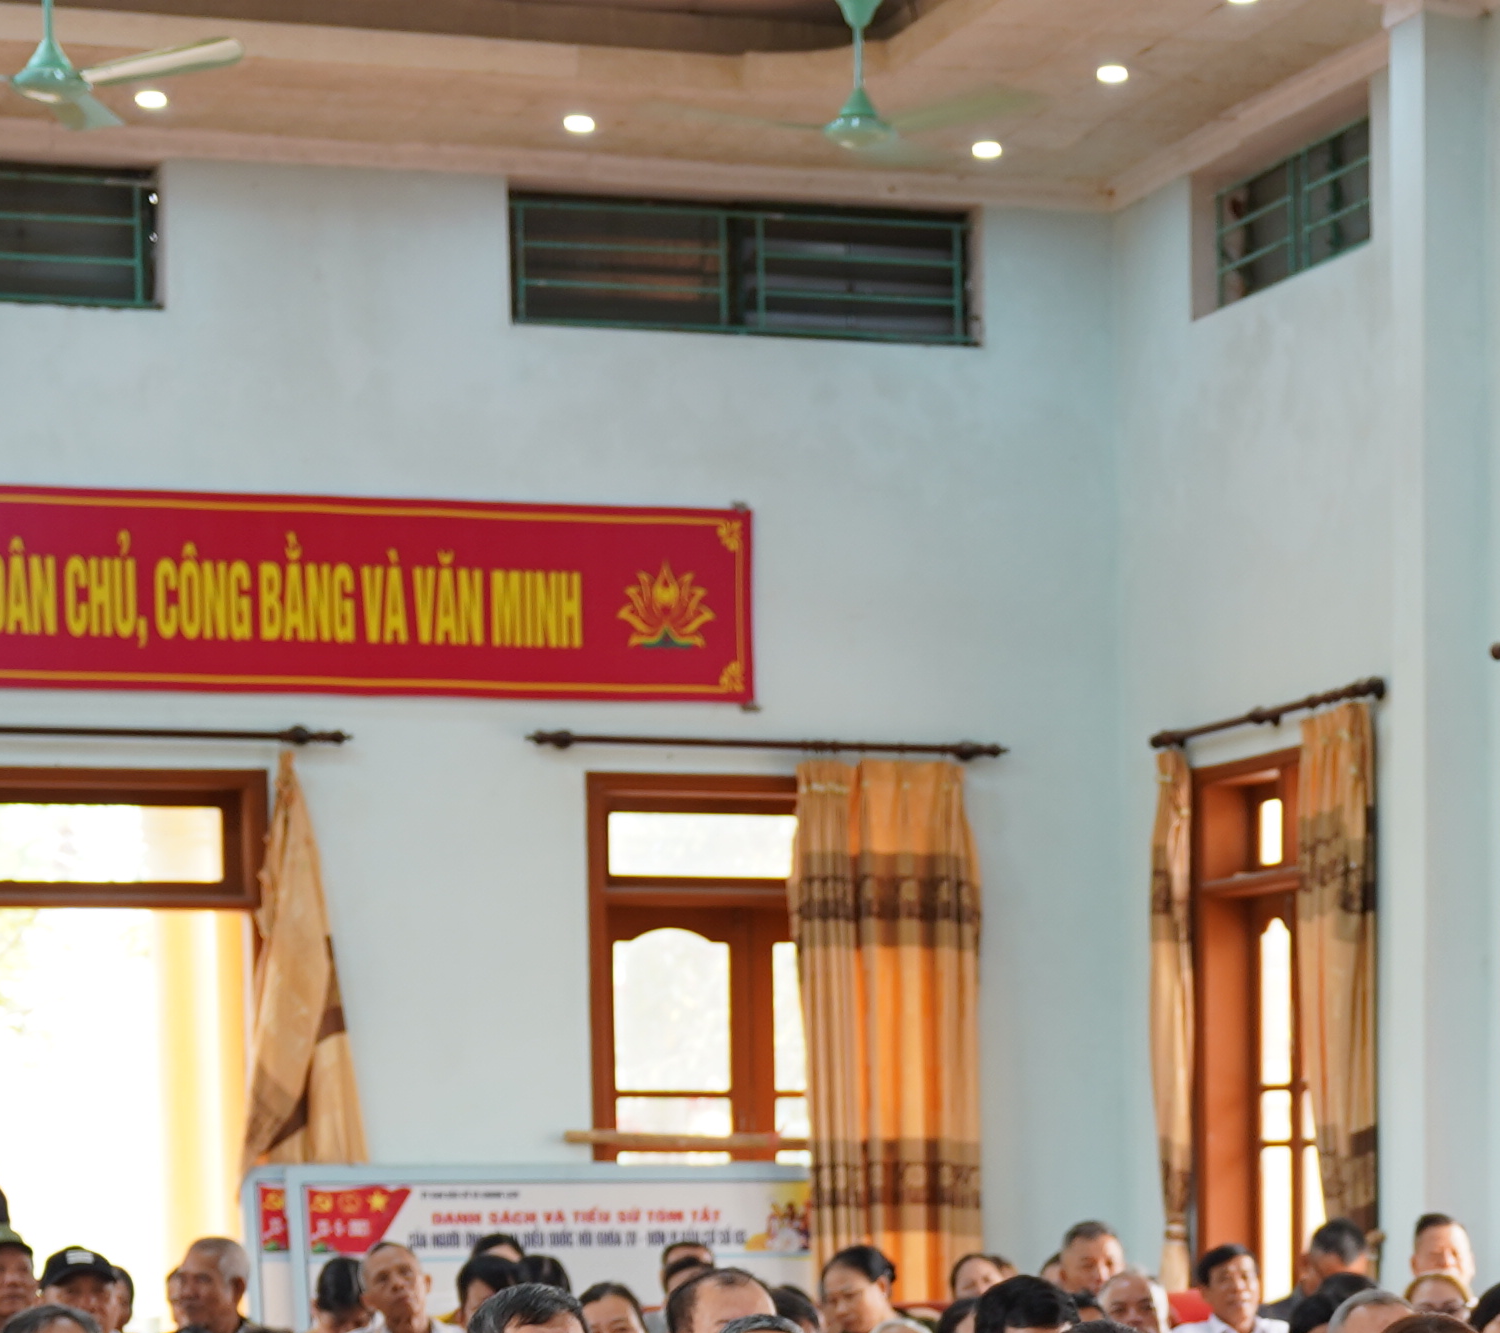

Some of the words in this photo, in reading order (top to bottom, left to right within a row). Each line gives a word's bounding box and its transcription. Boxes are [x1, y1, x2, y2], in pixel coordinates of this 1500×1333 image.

[63, 529, 148, 648] CHỦ,
[153, 541, 253, 642] CÔNG
[258, 531, 356, 644] BẰNG
[360, 548, 409, 645] VÀ
[412, 551, 485, 647] VĂN
[490, 568, 583, 649] MINH
[431, 1210, 482, 1226] DANH
[488, 1207, 537, 1225] SÁCH
[543, 1207, 565, 1224] VÀ
